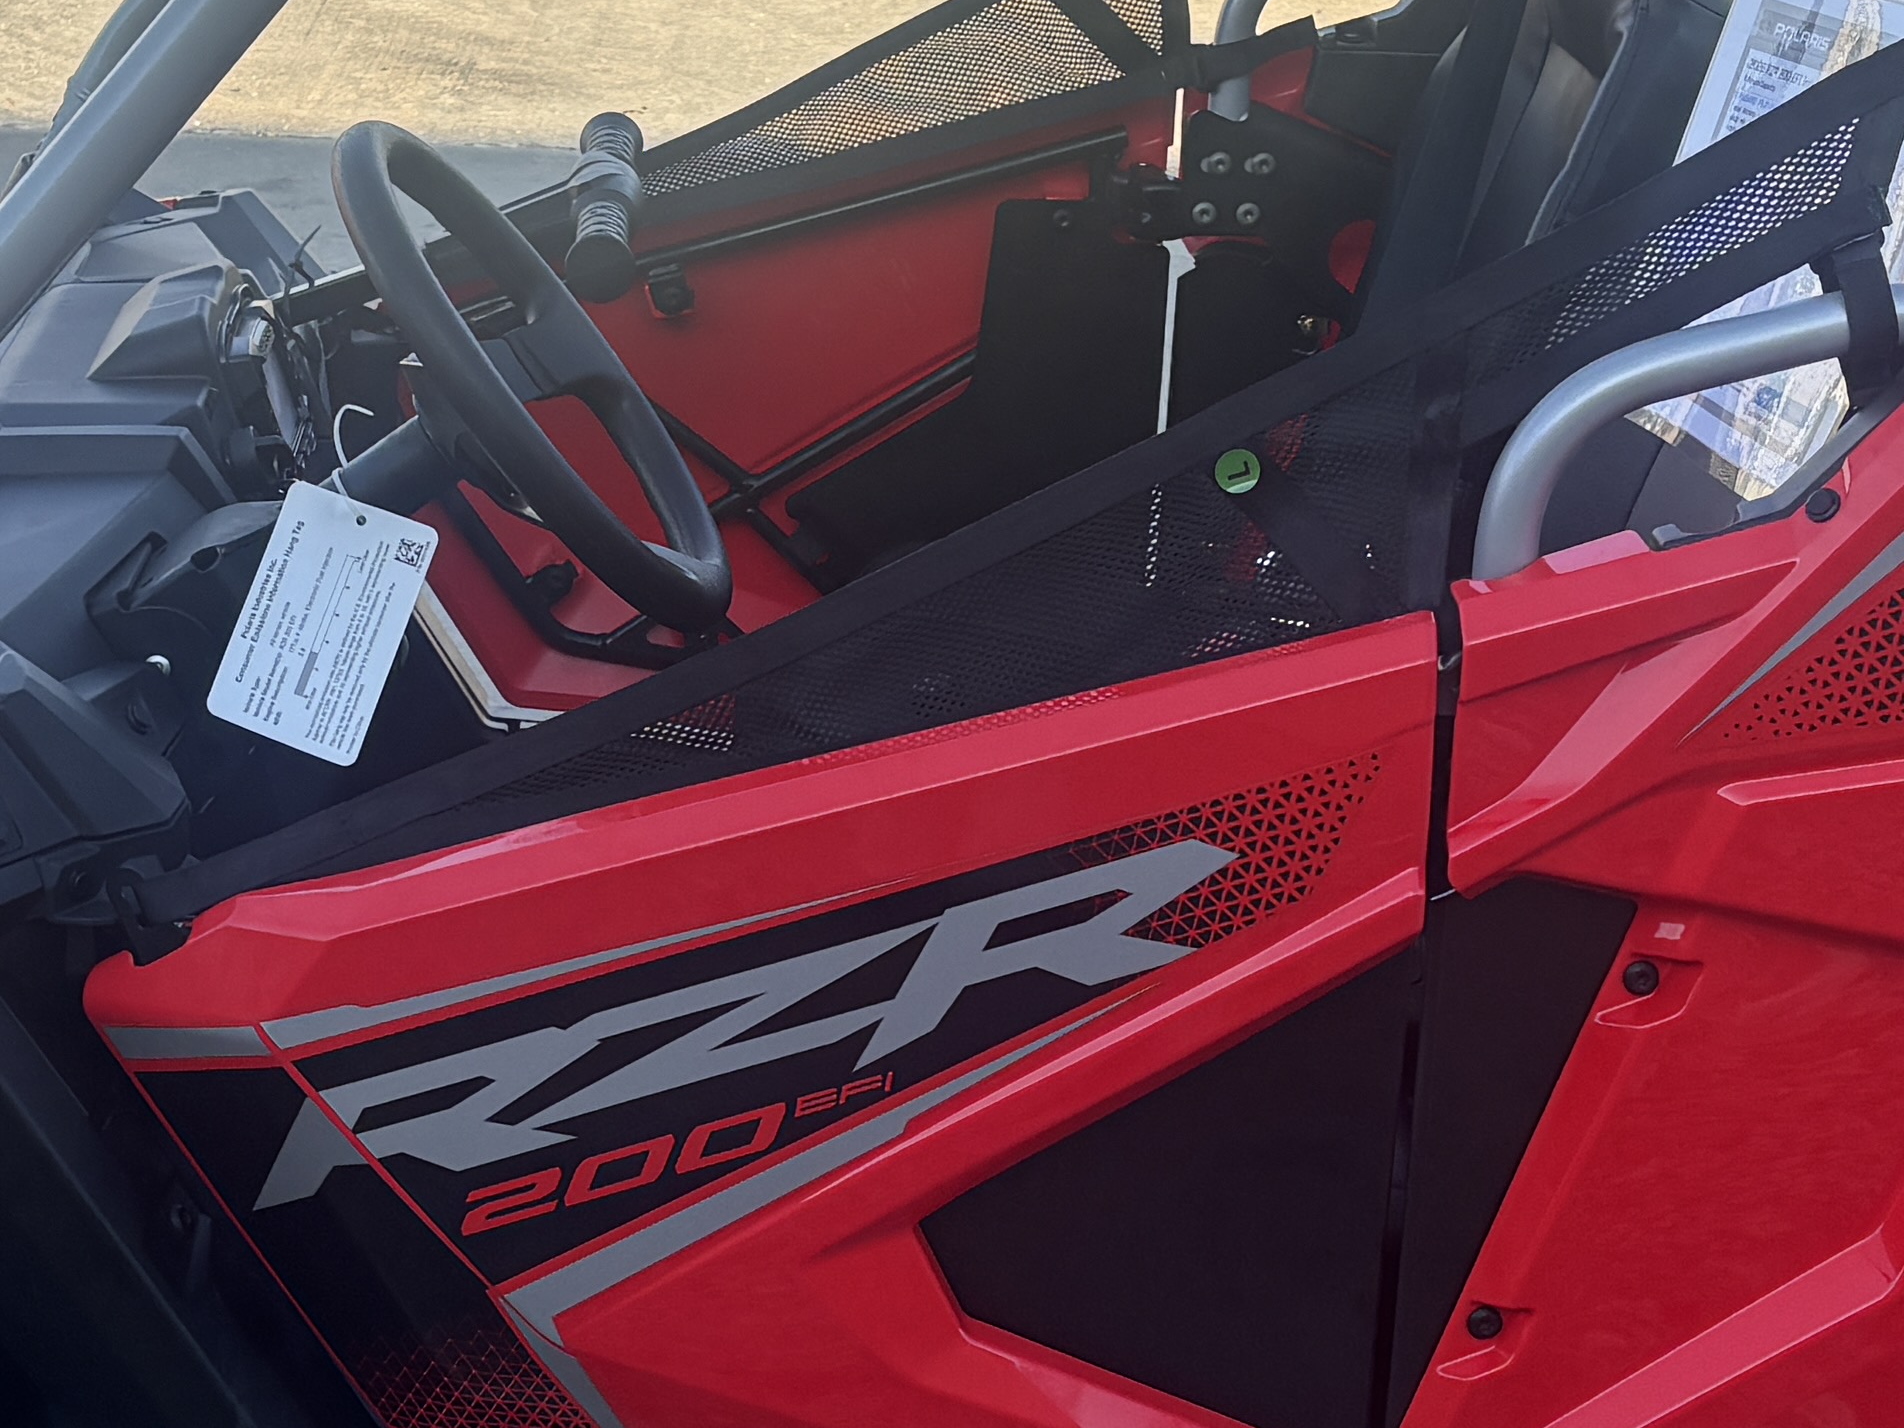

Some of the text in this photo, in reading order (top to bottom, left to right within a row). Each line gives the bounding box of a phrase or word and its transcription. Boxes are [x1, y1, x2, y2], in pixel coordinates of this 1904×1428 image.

[1774, 22, 1831, 51] POLARIS
[252, 838, 1241, 1212] RZR
[459, 1070, 895, 1237] 200 EFI
